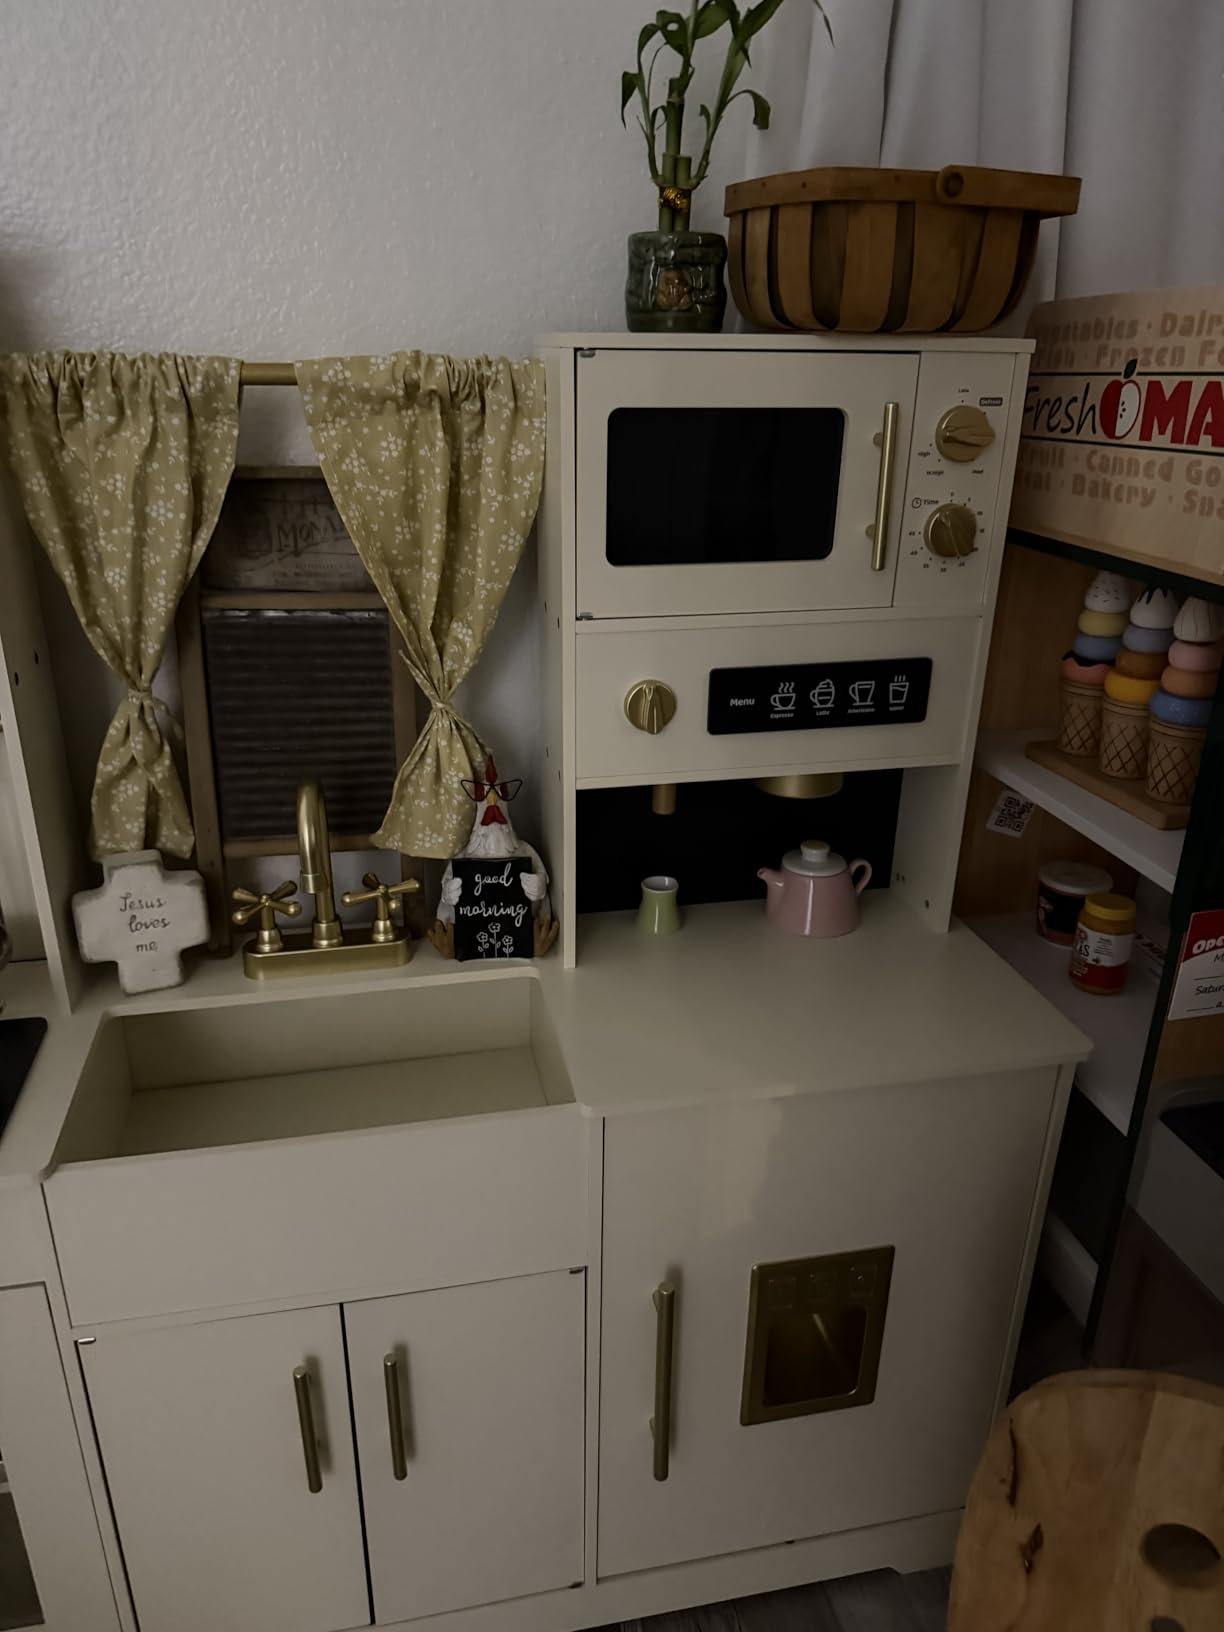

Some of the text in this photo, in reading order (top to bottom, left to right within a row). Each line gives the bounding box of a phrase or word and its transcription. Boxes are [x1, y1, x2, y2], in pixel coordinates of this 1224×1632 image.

[1159, 310, 1224, 338] Dair
[1023, 382, 1096, 436] Fresh
[1086, 449, 1175, 482] Canned
[1072, 473, 1157, 507] Bakery
[729, 697, 756, 707] Menu
[815, 709, 831, 717] Latte
[473, 862, 514, 897] good
[119, 892, 167, 913] Jesus
[459, 900, 529, 928] morning
[128, 914, 171, 933] loves
[136, 941, 158, 952] me
